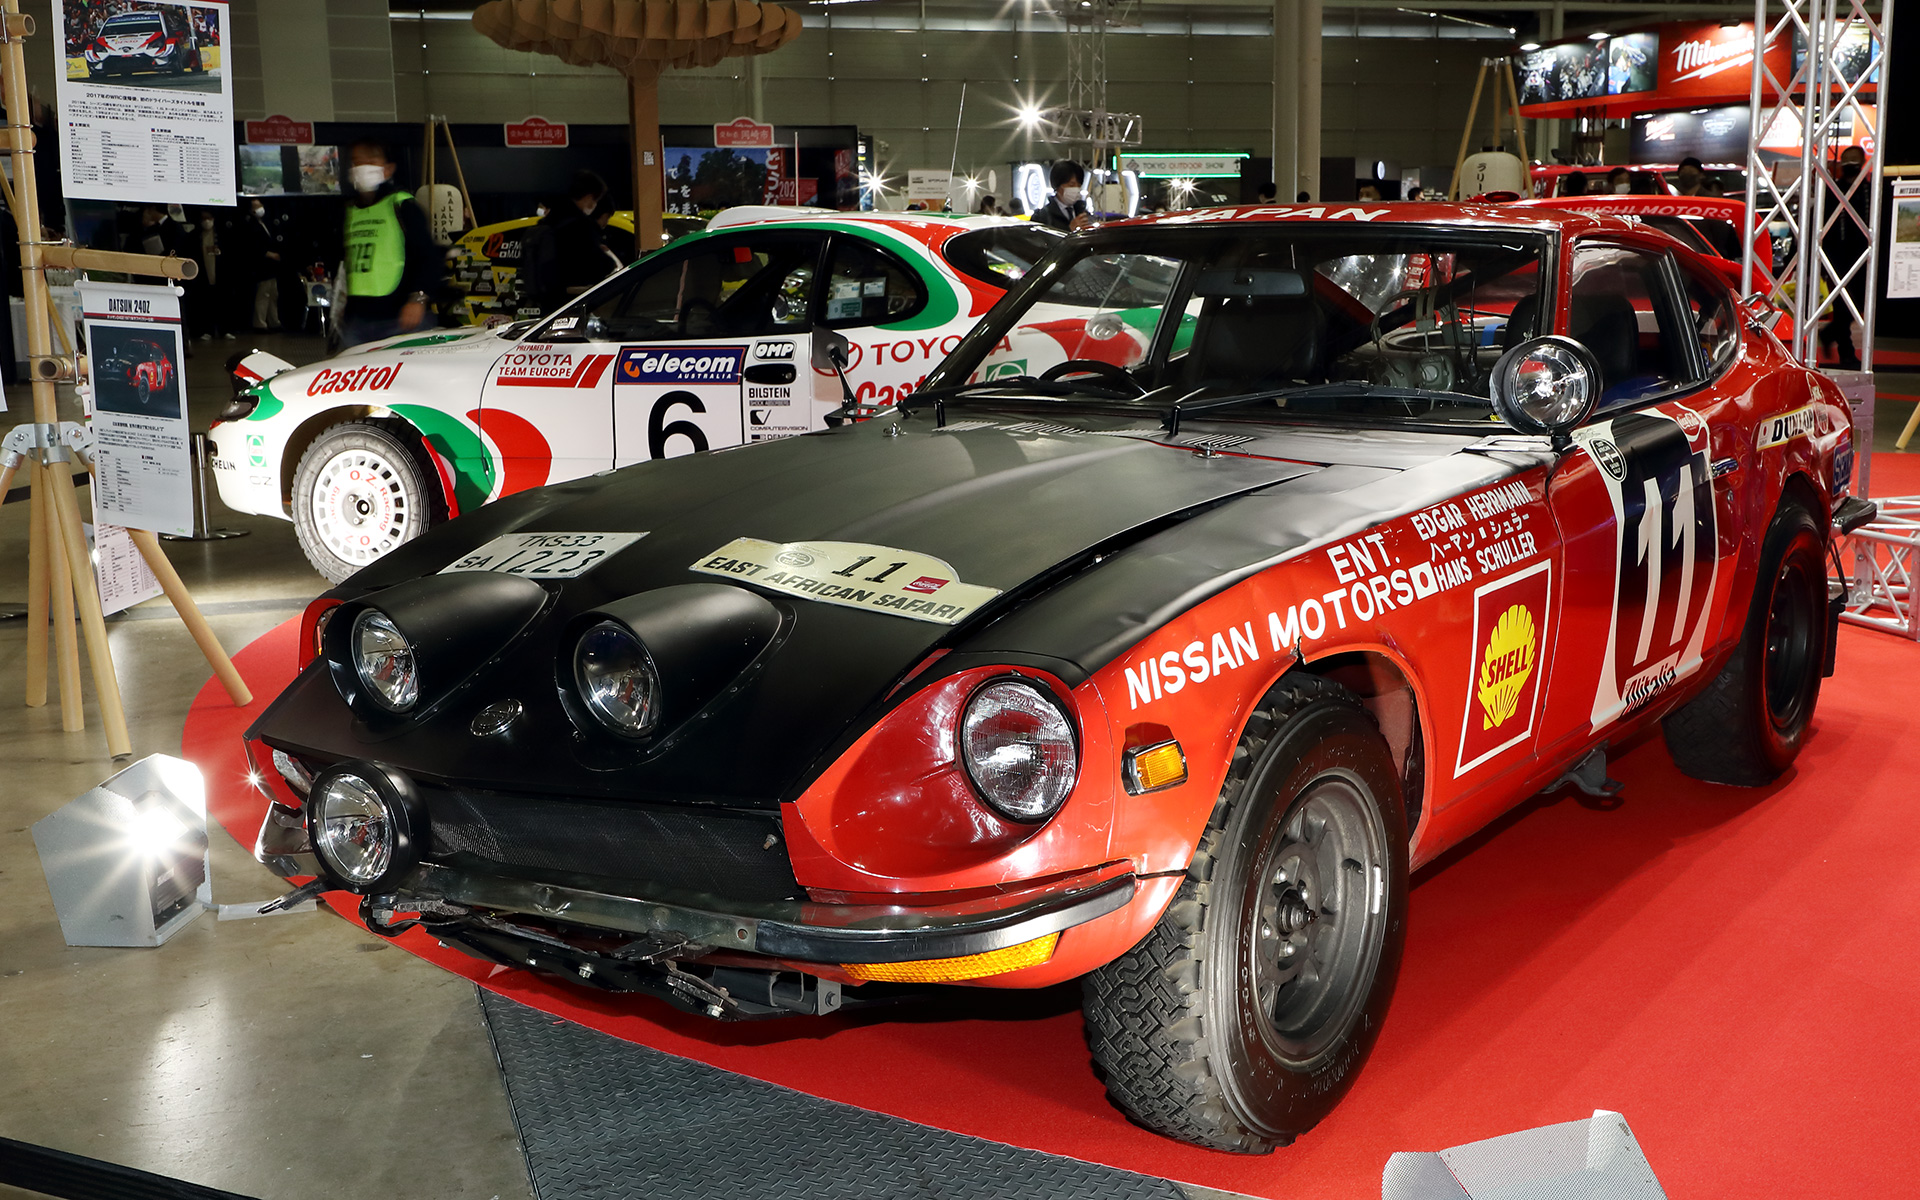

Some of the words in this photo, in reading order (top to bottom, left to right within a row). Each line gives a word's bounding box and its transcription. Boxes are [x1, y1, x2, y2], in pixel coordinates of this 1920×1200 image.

[780, 180, 796, 198] 202
[1477, 163, 1487, 192] ラリー
[440, 207, 448, 240] JAPAN
[1641, 206, 1733, 218] MOTORS
[485, 232, 505, 258] 12
[506, 249, 522, 258] MU
[109, 298, 133, 312] DATSUN
[134, 299, 151, 314] 240Z
[503, 353, 573, 367] TOYOTA
[755, 343, 795, 357] OMP
[871, 335, 1013, 365] TOYOA
[308, 361, 404, 397] Castrol
[499, 366, 527, 376] TEAM
[530, 366, 572, 377] EUROPE
[624, 352, 736, 378] Telecom
[677, 372, 733, 380] AUSTRALIA
[749, 387, 791, 398] BILSTEIN
[648, 390, 710, 460] 6
[379, 487, 393, 532] Racing
[1411, 502, 1466, 542] EDGAR
[1467, 480, 1533, 520] HERRMANN
[455, 555, 494, 569] SA
[489, 549, 606, 574] 1223
[831, 554, 908, 584] 11
[1326, 532, 1402, 588] ENT.
[1434, 557, 1473, 598] HANS
[1475, 530, 1538, 576] SCHULLER
[1633, 463, 1696, 667] 11
[703, 556, 769, 577] EAST
[771, 572, 874, 604] AFRICAN
[874, 593, 966, 620] SAFARI
[1123, 620, 1260, 711] NISSAN
[1268, 569, 1414, 653] MOTORS
[1486, 643, 1529, 690] SHELL
